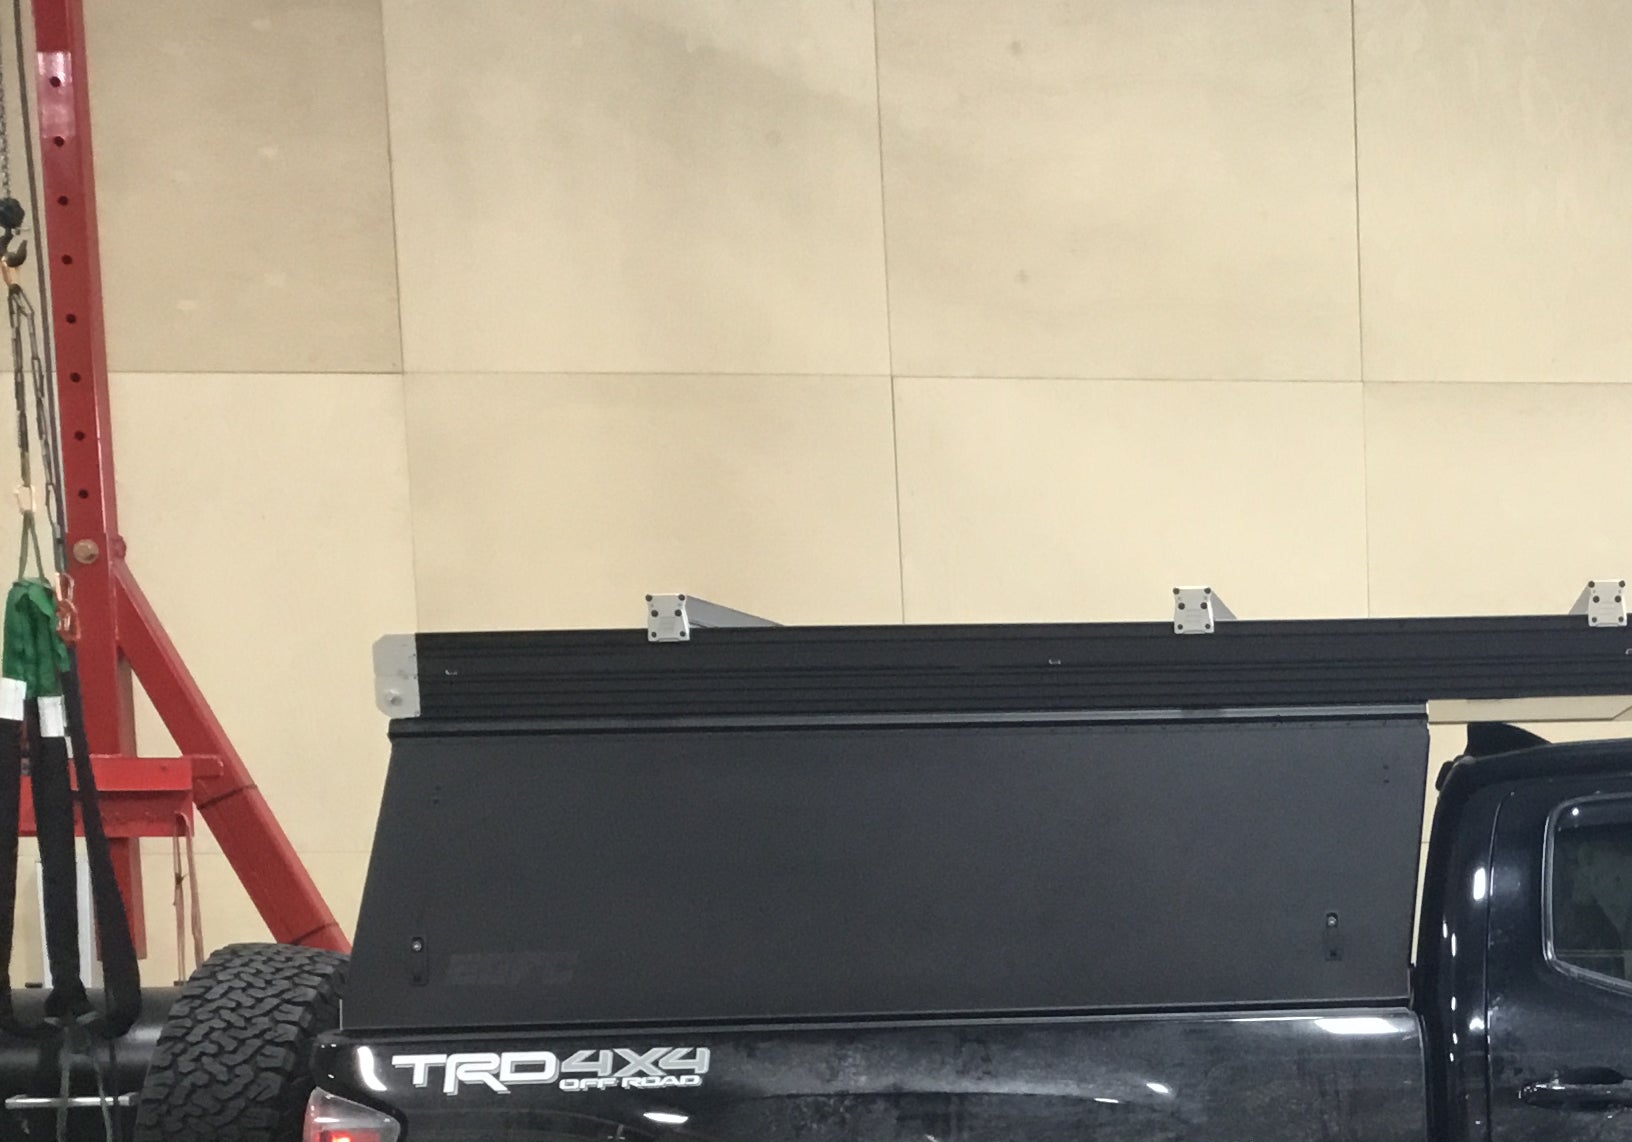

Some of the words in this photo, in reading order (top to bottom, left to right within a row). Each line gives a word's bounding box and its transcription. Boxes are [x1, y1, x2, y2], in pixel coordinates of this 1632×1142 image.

[391, 1051, 560, 1096] TRD
[559, 1076, 617, 1092] OFF
[621, 1074, 702, 1091] ROAD
